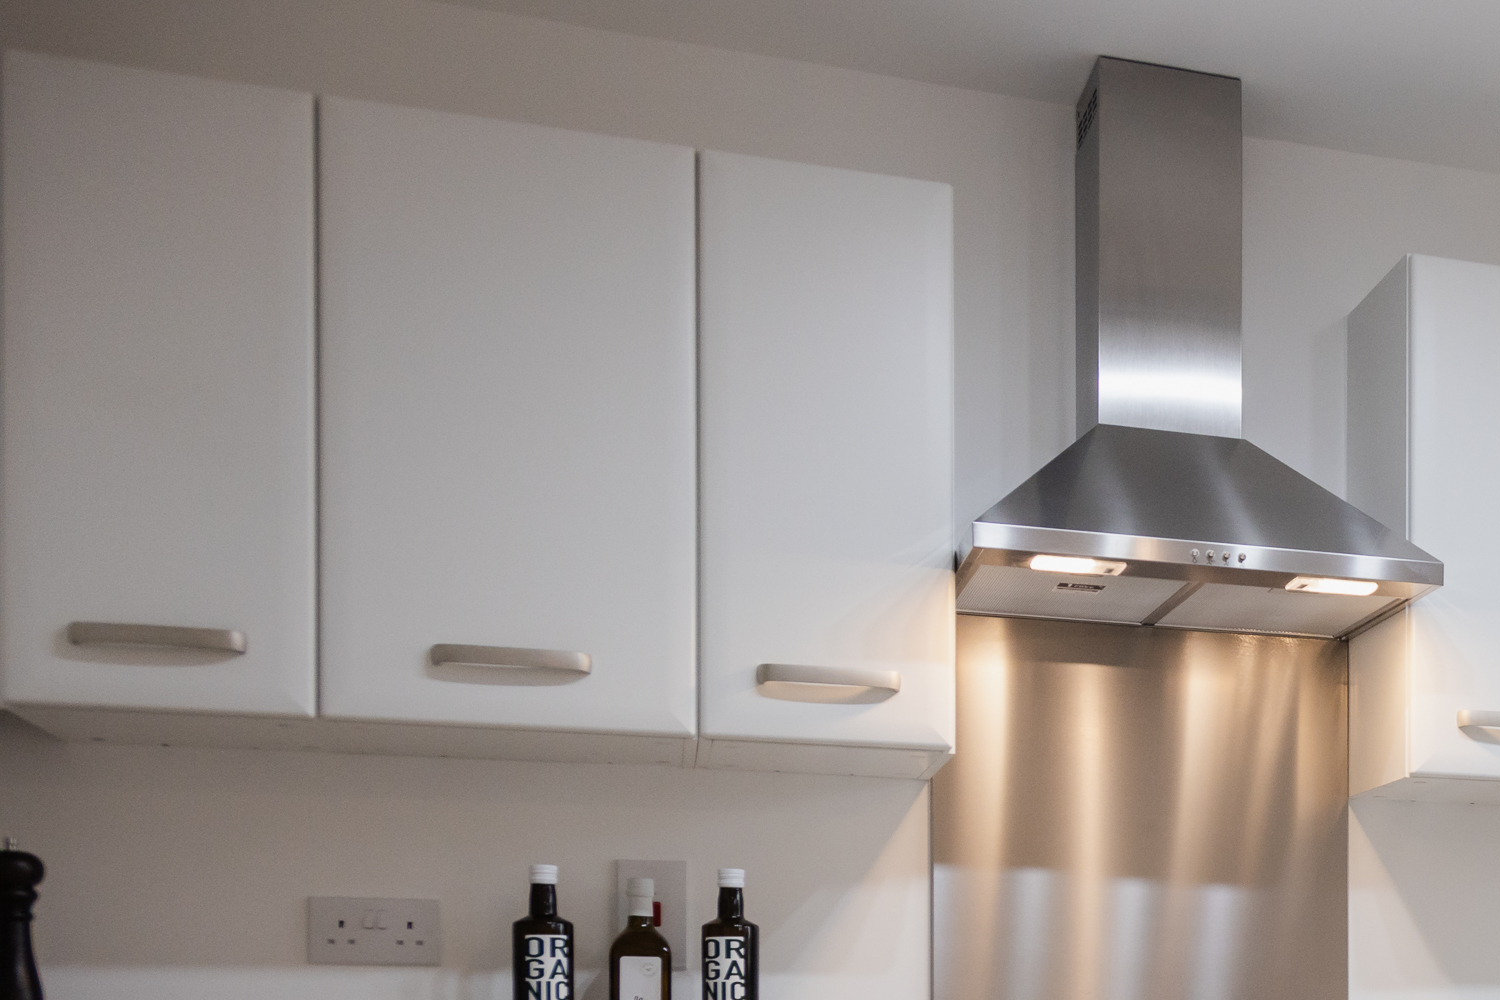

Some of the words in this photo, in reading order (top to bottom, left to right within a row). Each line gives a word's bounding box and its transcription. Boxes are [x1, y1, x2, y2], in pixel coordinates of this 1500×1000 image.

[525, 937, 569, 958] OR
[705, 939, 746, 959] OR
[525, 959, 569, 979] GA
[705, 960, 746, 980] GA
